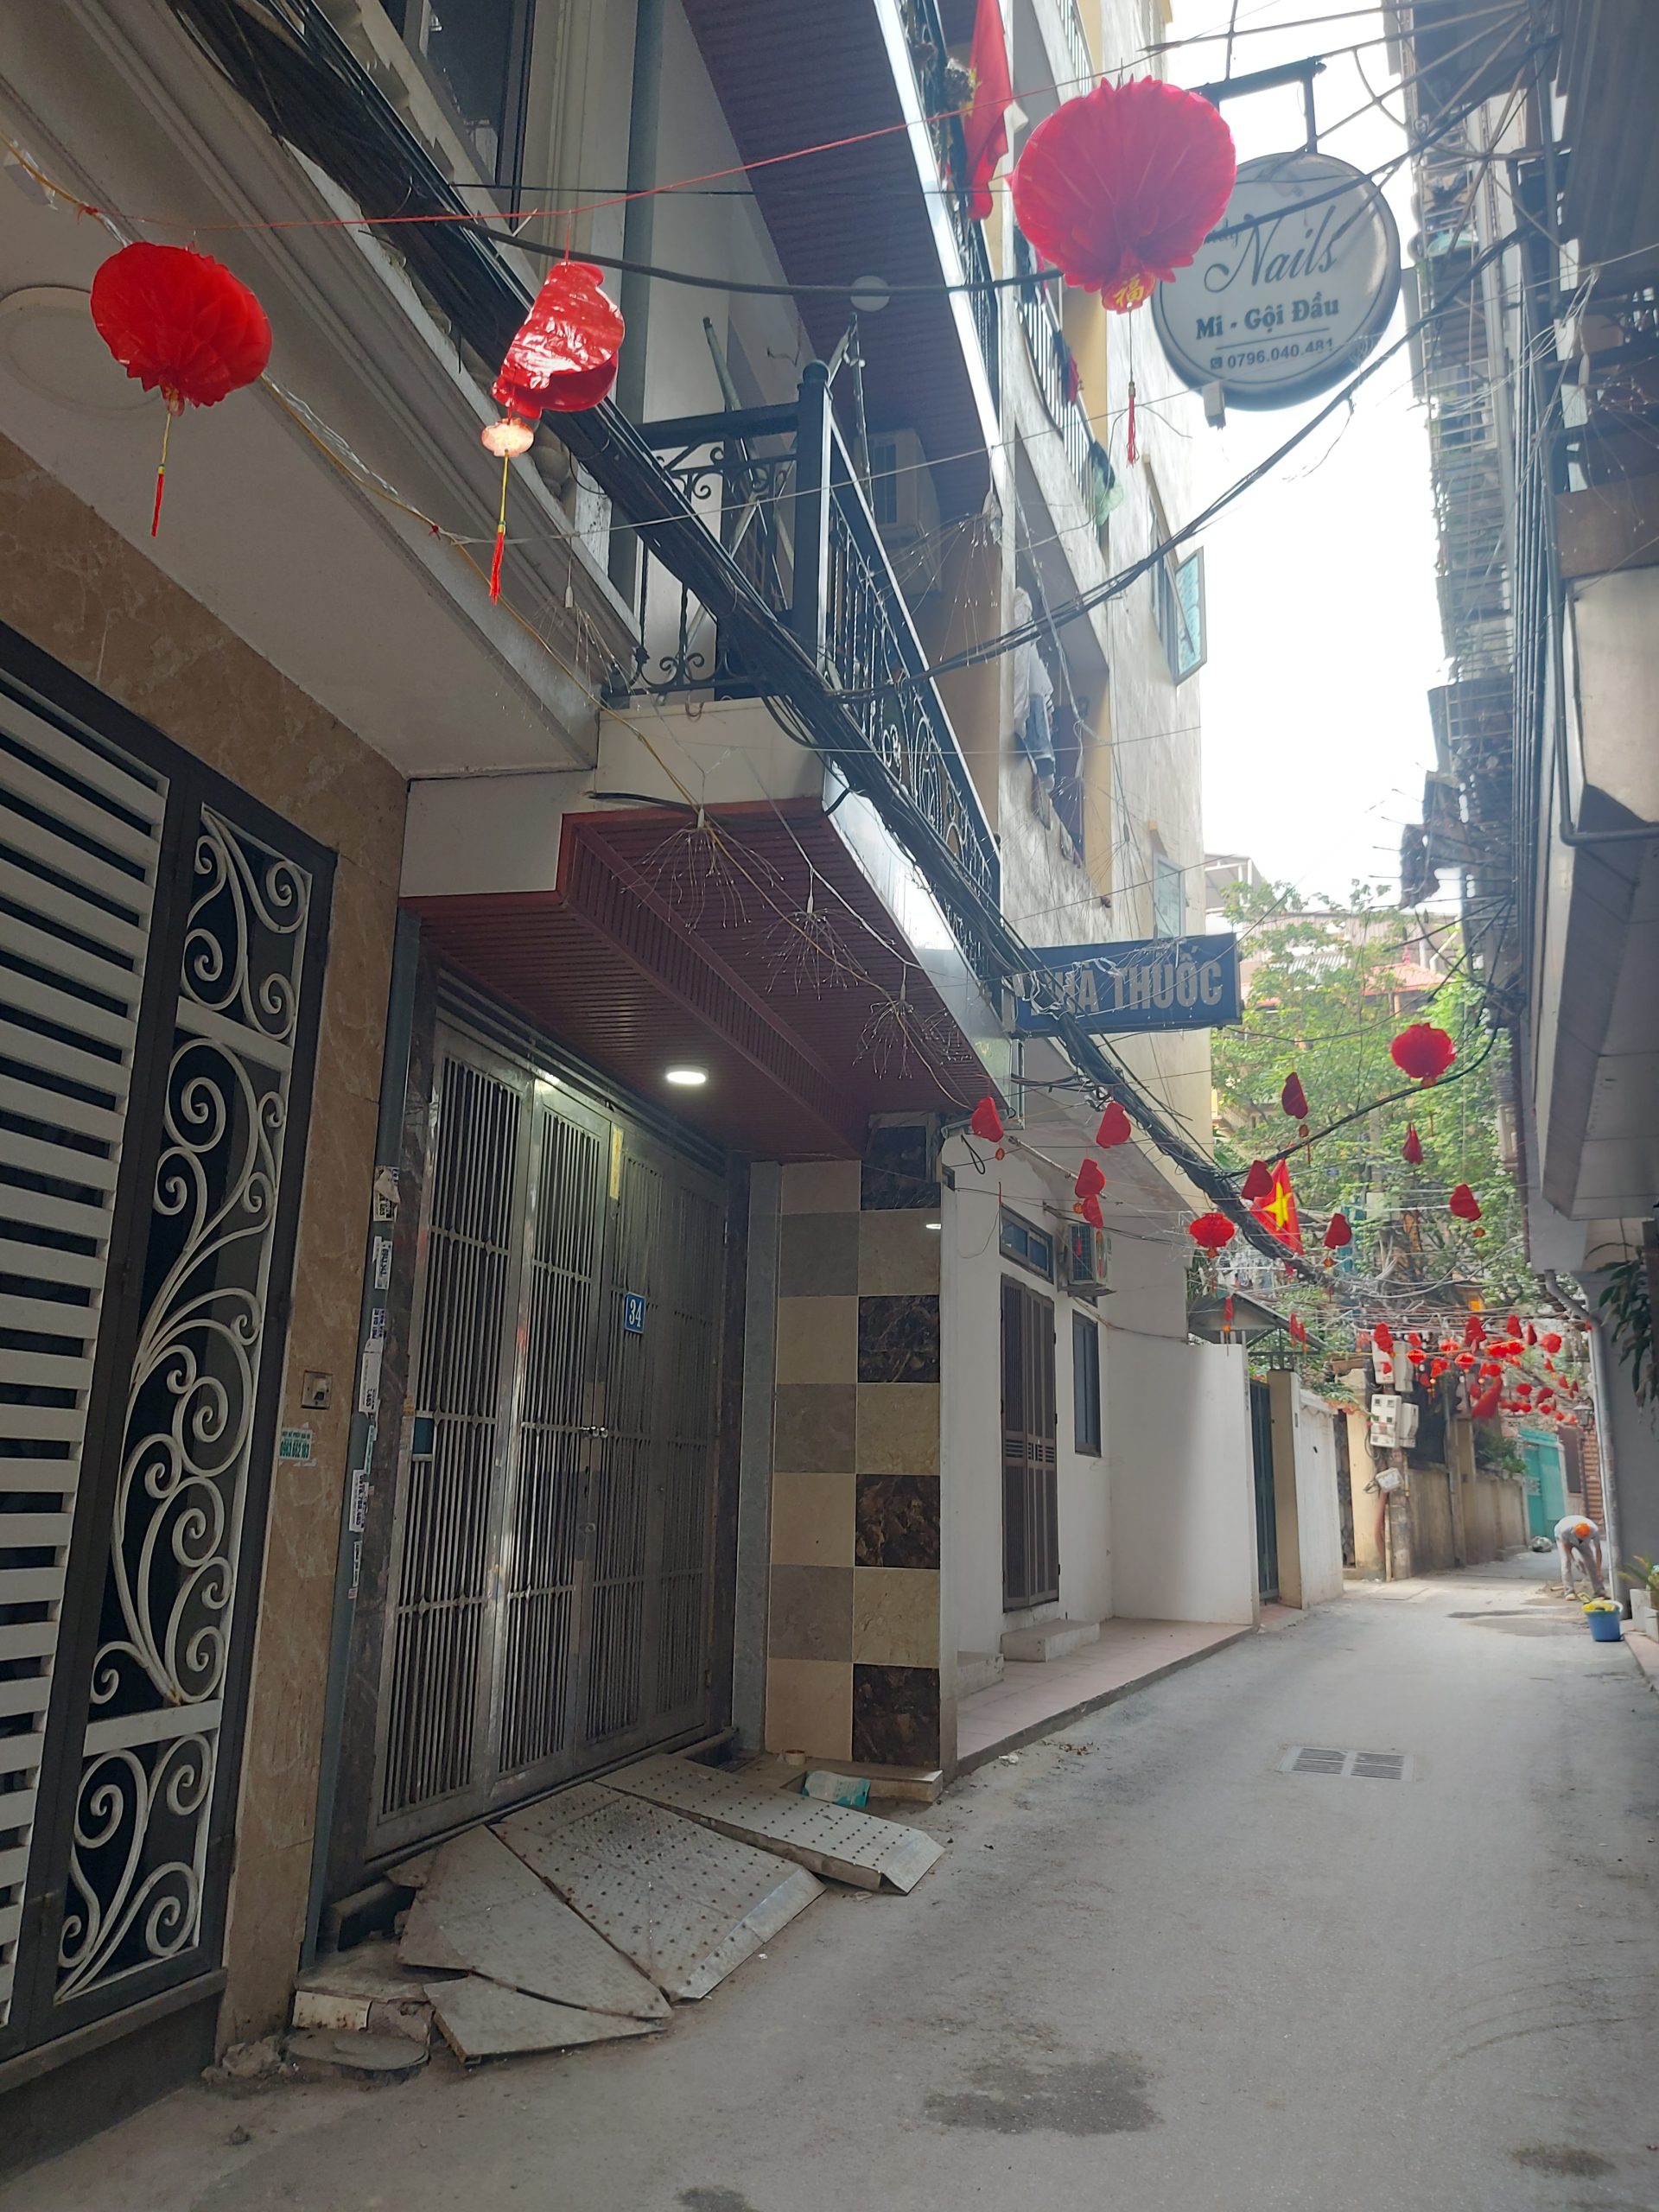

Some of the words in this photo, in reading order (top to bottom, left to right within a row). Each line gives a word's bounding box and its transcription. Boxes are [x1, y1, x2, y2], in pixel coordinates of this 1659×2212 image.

[1196, 315, 1224, 340] Mi
[1244, 304, 1284, 334] Gội
[1292, 291, 1339, 322] Đầu
[1227, 338, 1333, 369] 0796.040.481
[1111, 945, 1223, 1011] THUỐC
[629, 1299, 642, 1328] 34
